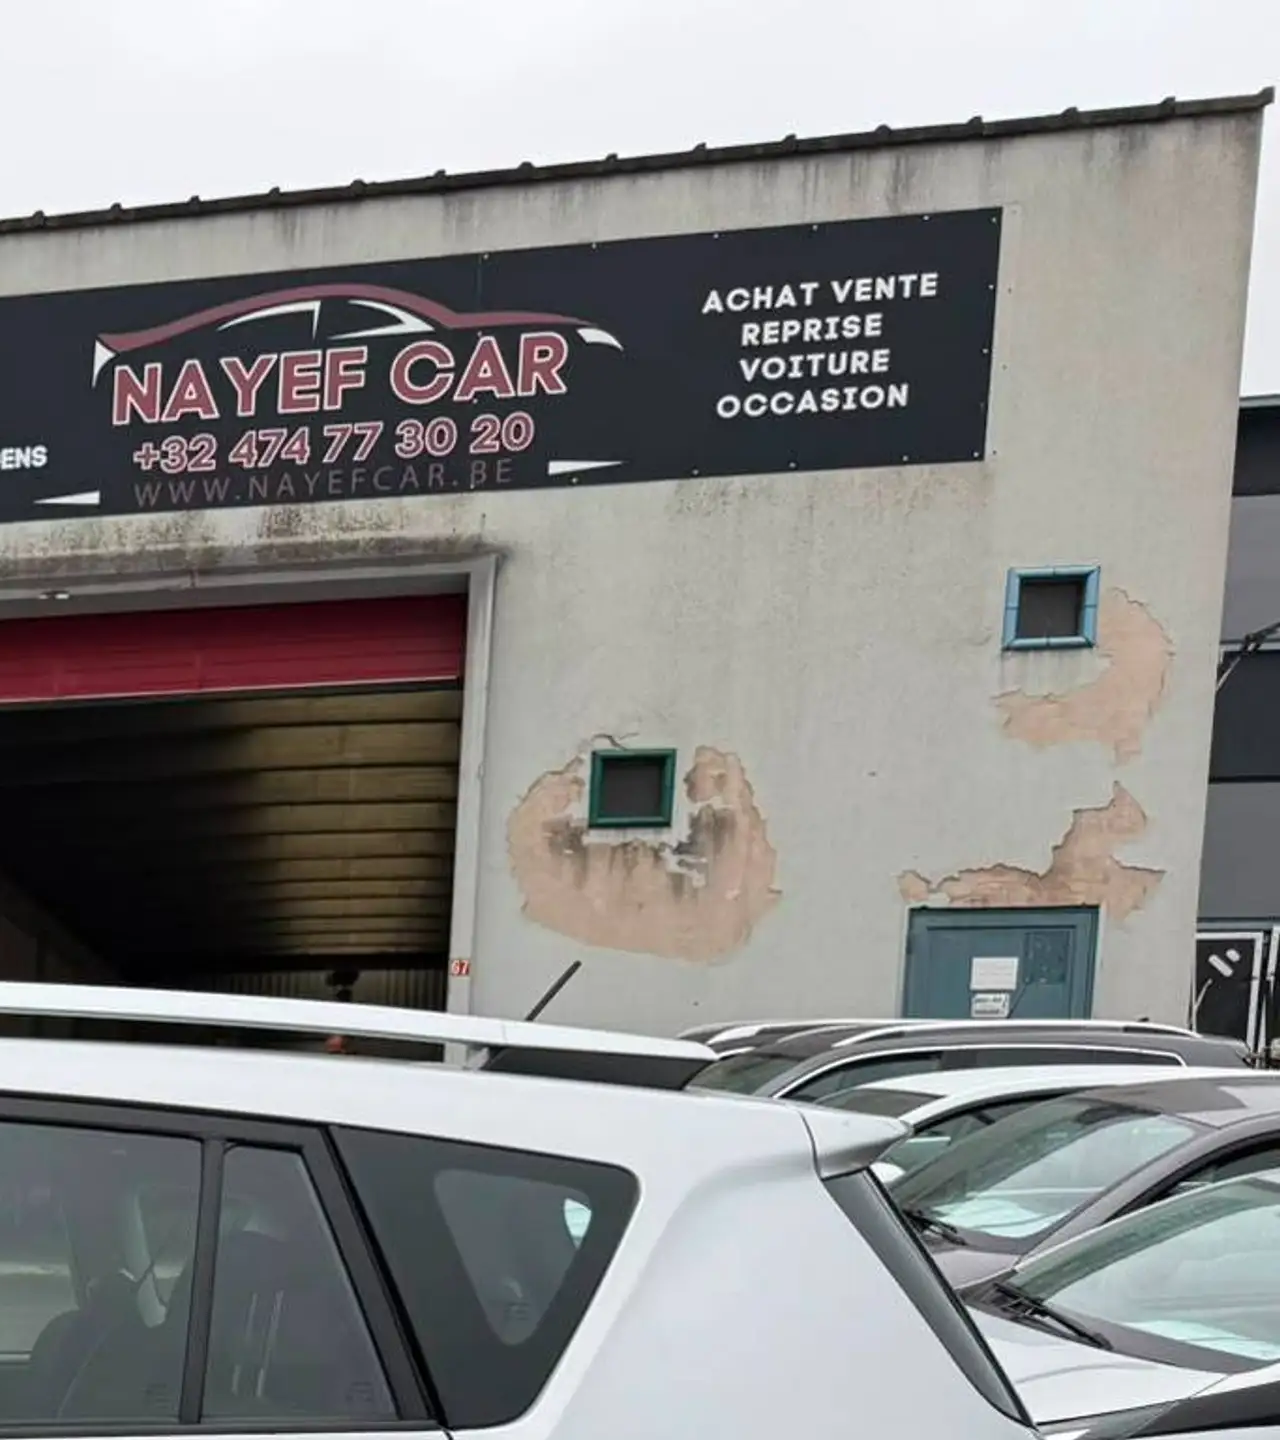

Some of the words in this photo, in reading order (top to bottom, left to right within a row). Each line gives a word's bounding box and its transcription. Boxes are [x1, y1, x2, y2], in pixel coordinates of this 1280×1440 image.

[702, 282, 819, 315] ACHAT
[832, 272, 939, 303] VENTE
[740, 313, 883, 346] REPRISE
[111, 345, 369, 426] NAYEF
[390, 331, 568, 405] CAR
[739, 348, 890, 382] VOITURE
[716, 383, 909, 419] OCCASION
[132, 433, 217, 474] +32
[228, 426, 311, 468] 474
[322, 421, 384, 463] 77
[394, 416, 458, 459] 30
[469, 411, 535, 454] 20
[132, 458, 517, 509] WWW.NAYEFCAR.BE
